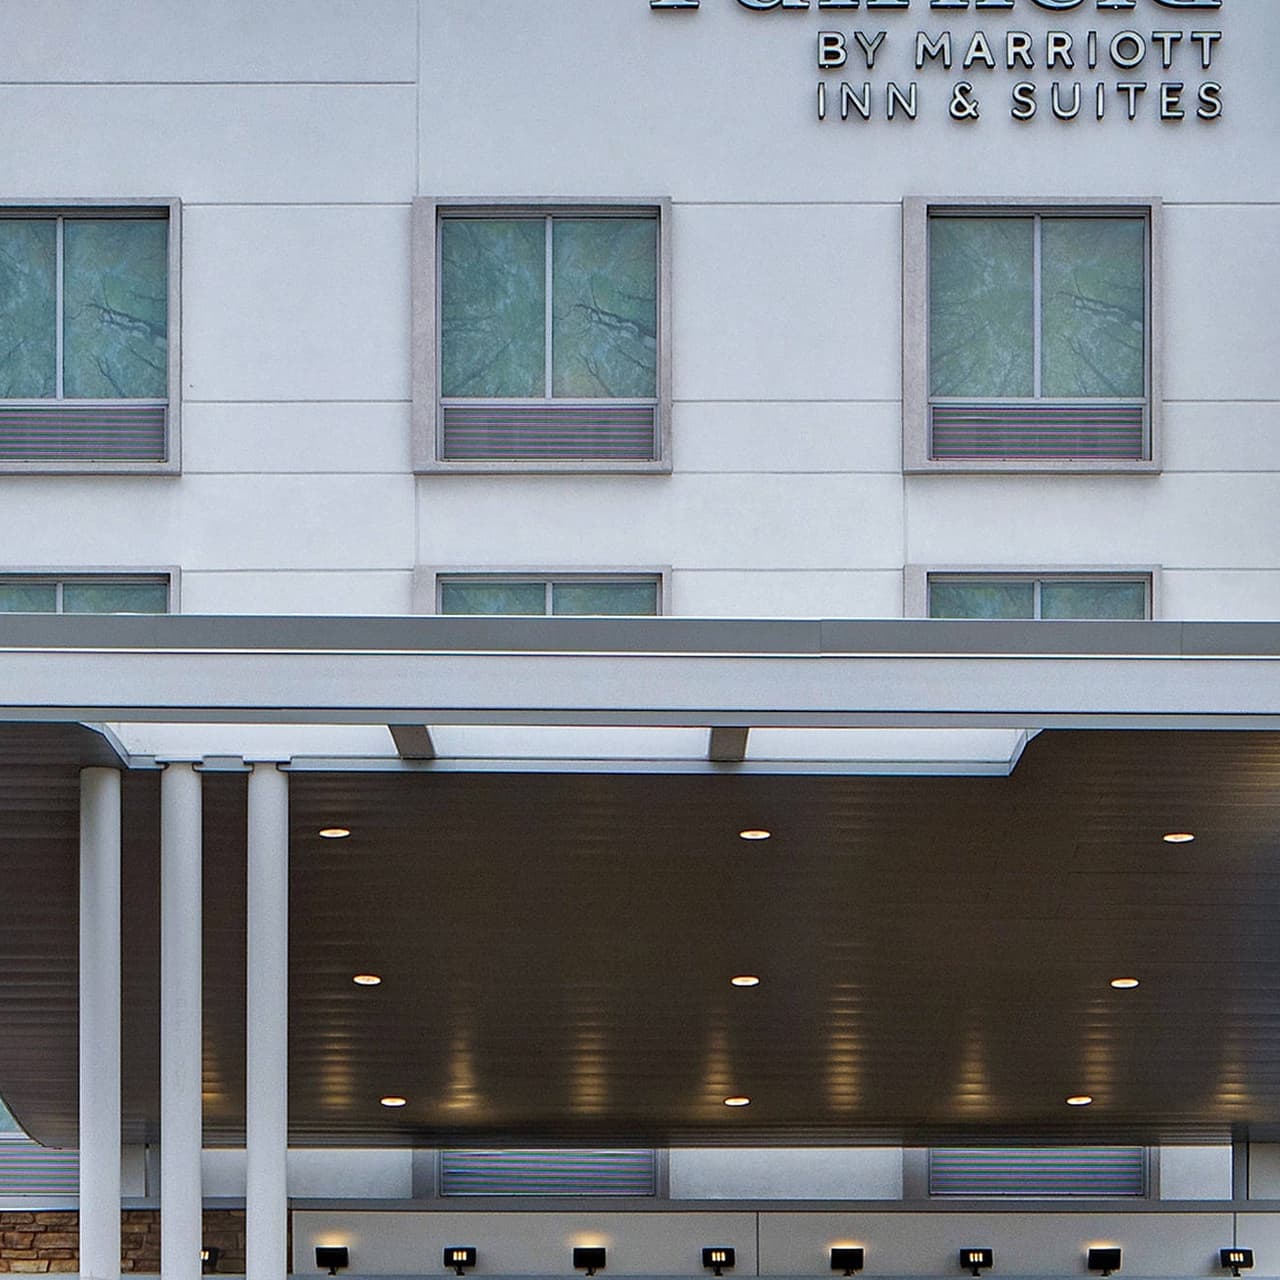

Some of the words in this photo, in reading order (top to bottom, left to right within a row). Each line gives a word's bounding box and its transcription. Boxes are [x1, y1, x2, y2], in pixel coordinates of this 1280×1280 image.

[817, 30, 888, 69] BY
[914, 30, 1223, 69] MARRIOTT
[817, 81, 919, 119] INN
[949, 81, 979, 119] &
[1010, 81, 1223, 119] SUITES
